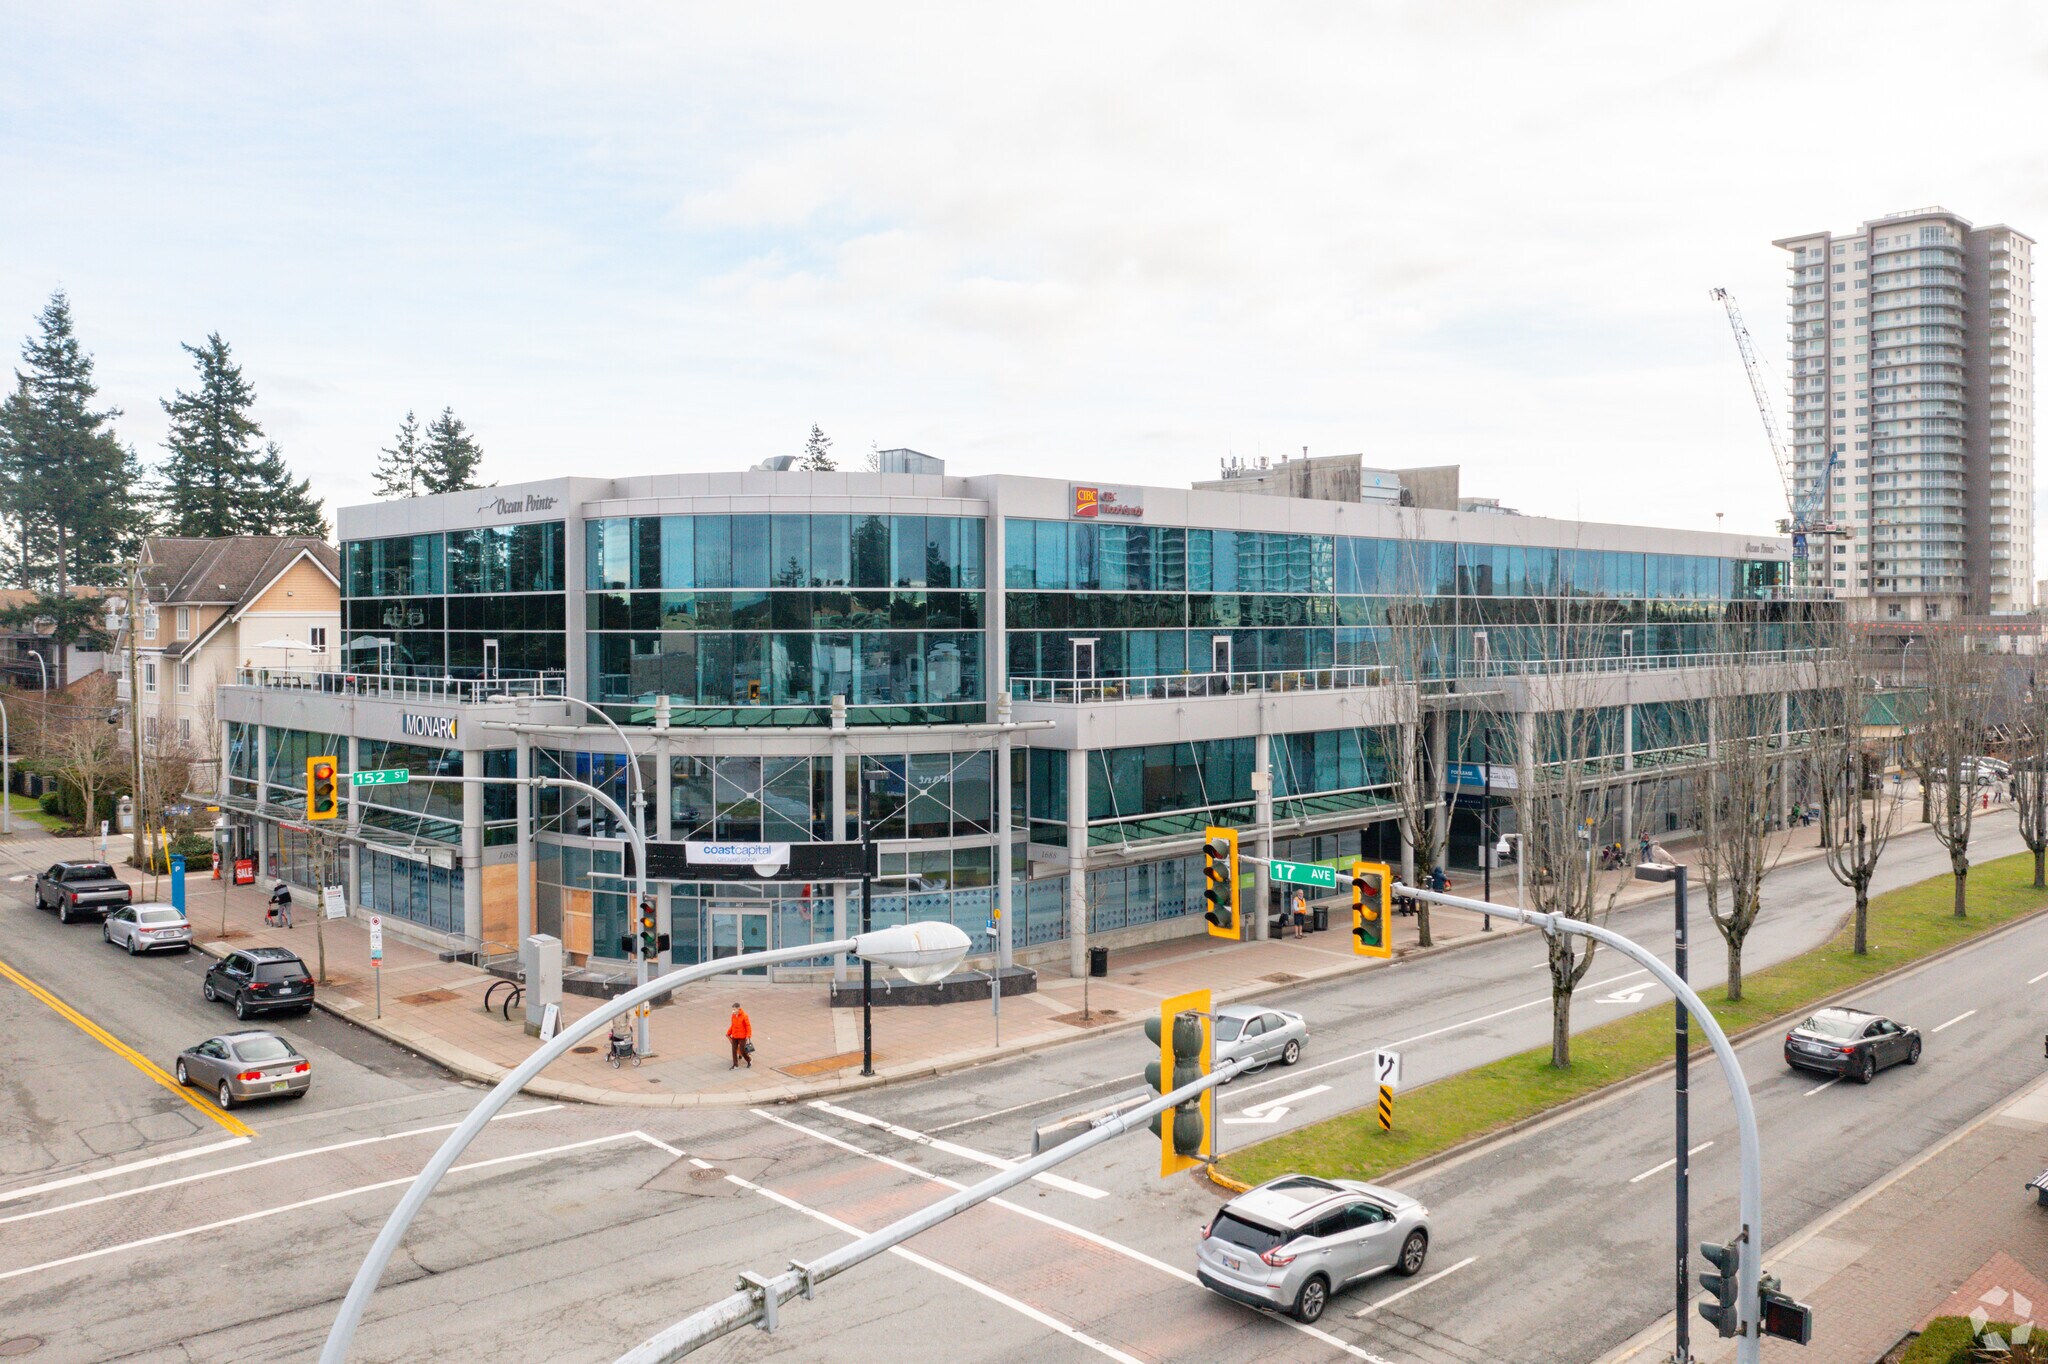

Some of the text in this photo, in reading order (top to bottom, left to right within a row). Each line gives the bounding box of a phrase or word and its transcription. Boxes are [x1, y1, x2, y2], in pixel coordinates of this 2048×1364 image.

[1078, 490, 1097, 501] CIBC
[497, 494, 558, 514] Ocean Pointe
[406, 714, 456, 739] MONARK
[356, 770, 405, 784] 152 ST
[703, 845, 772, 857] coastcapital
[1041, 850, 1057, 859] 1688
[236, 867, 253, 878] SALE
[1275, 864, 1331, 881] 17 AVE
